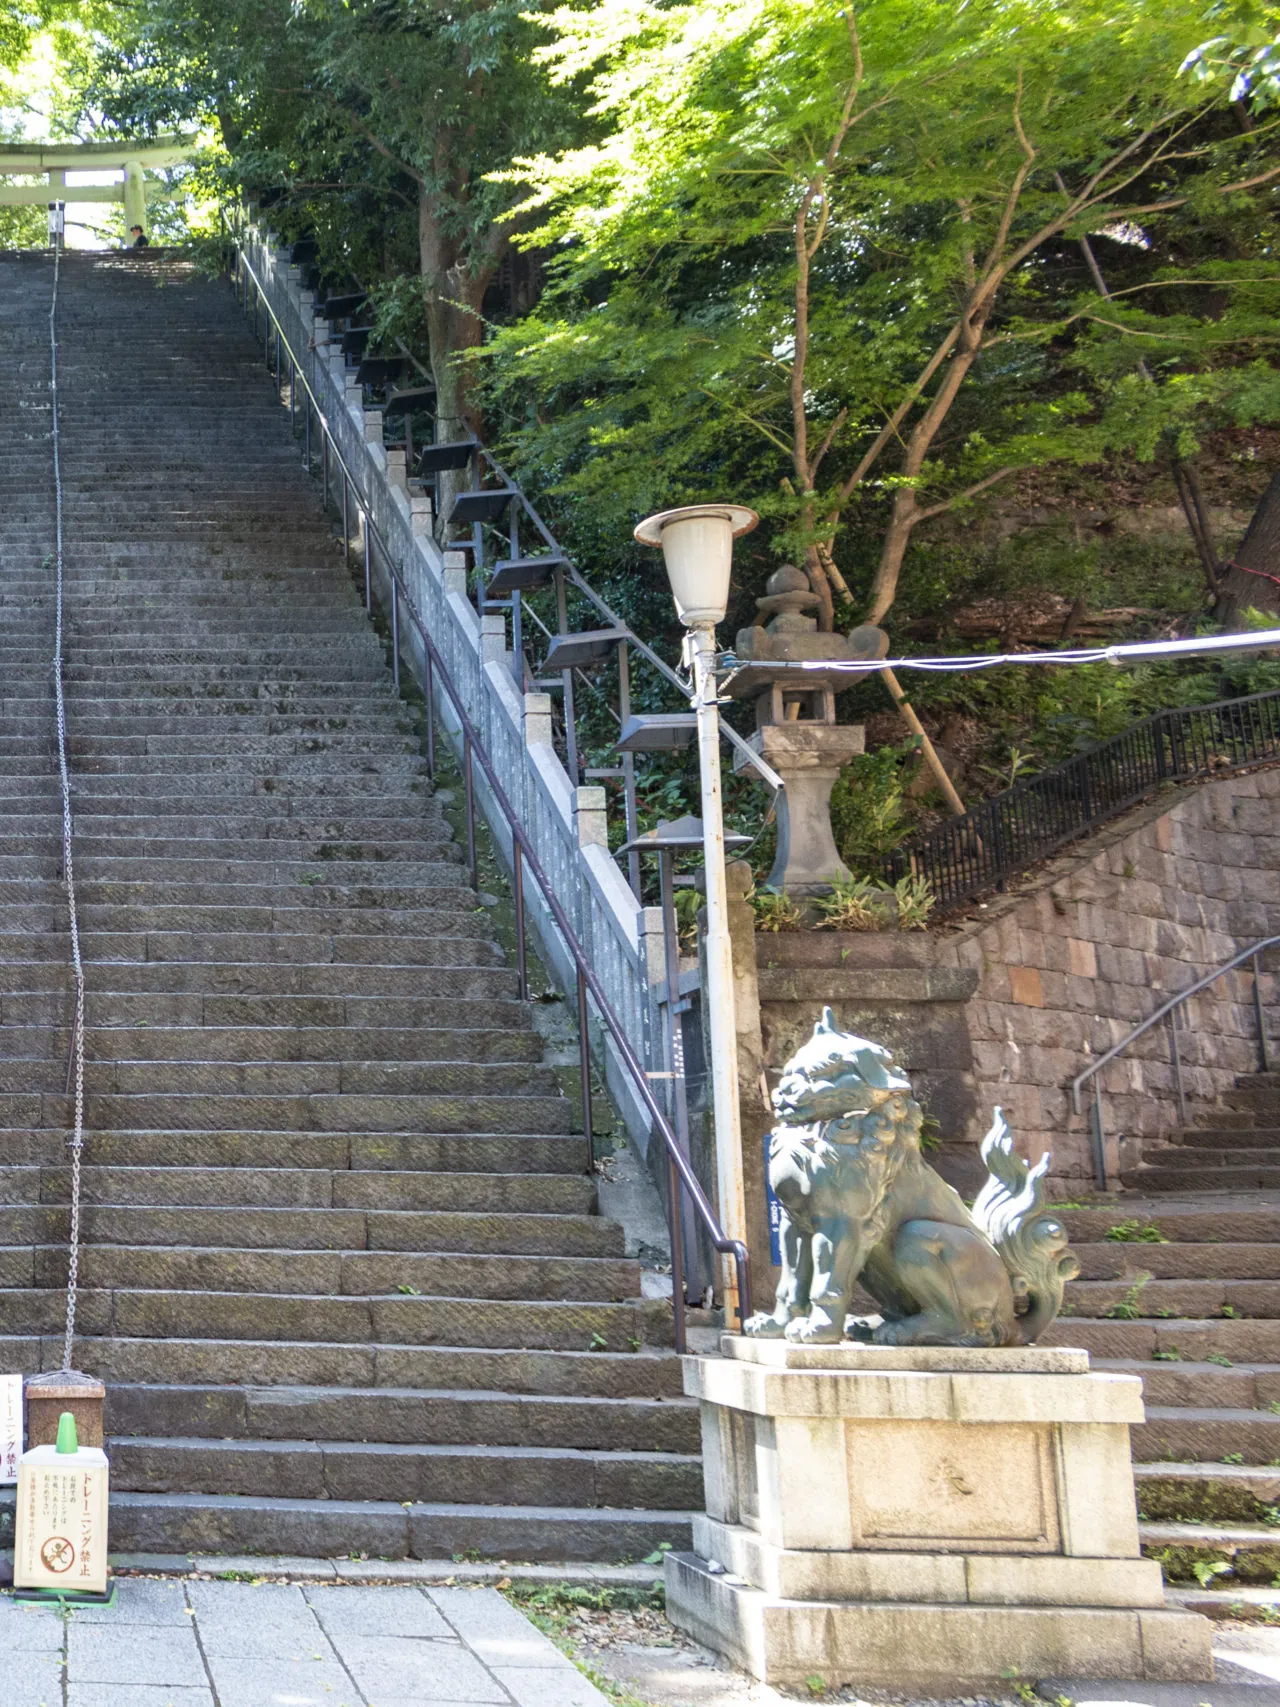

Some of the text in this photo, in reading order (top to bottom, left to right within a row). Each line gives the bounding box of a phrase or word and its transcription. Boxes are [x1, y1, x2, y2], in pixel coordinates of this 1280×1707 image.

[6, 1381, 17, 1478] トレーニング禁止
[79, 1472, 93, 1577] トレーニング禁止
